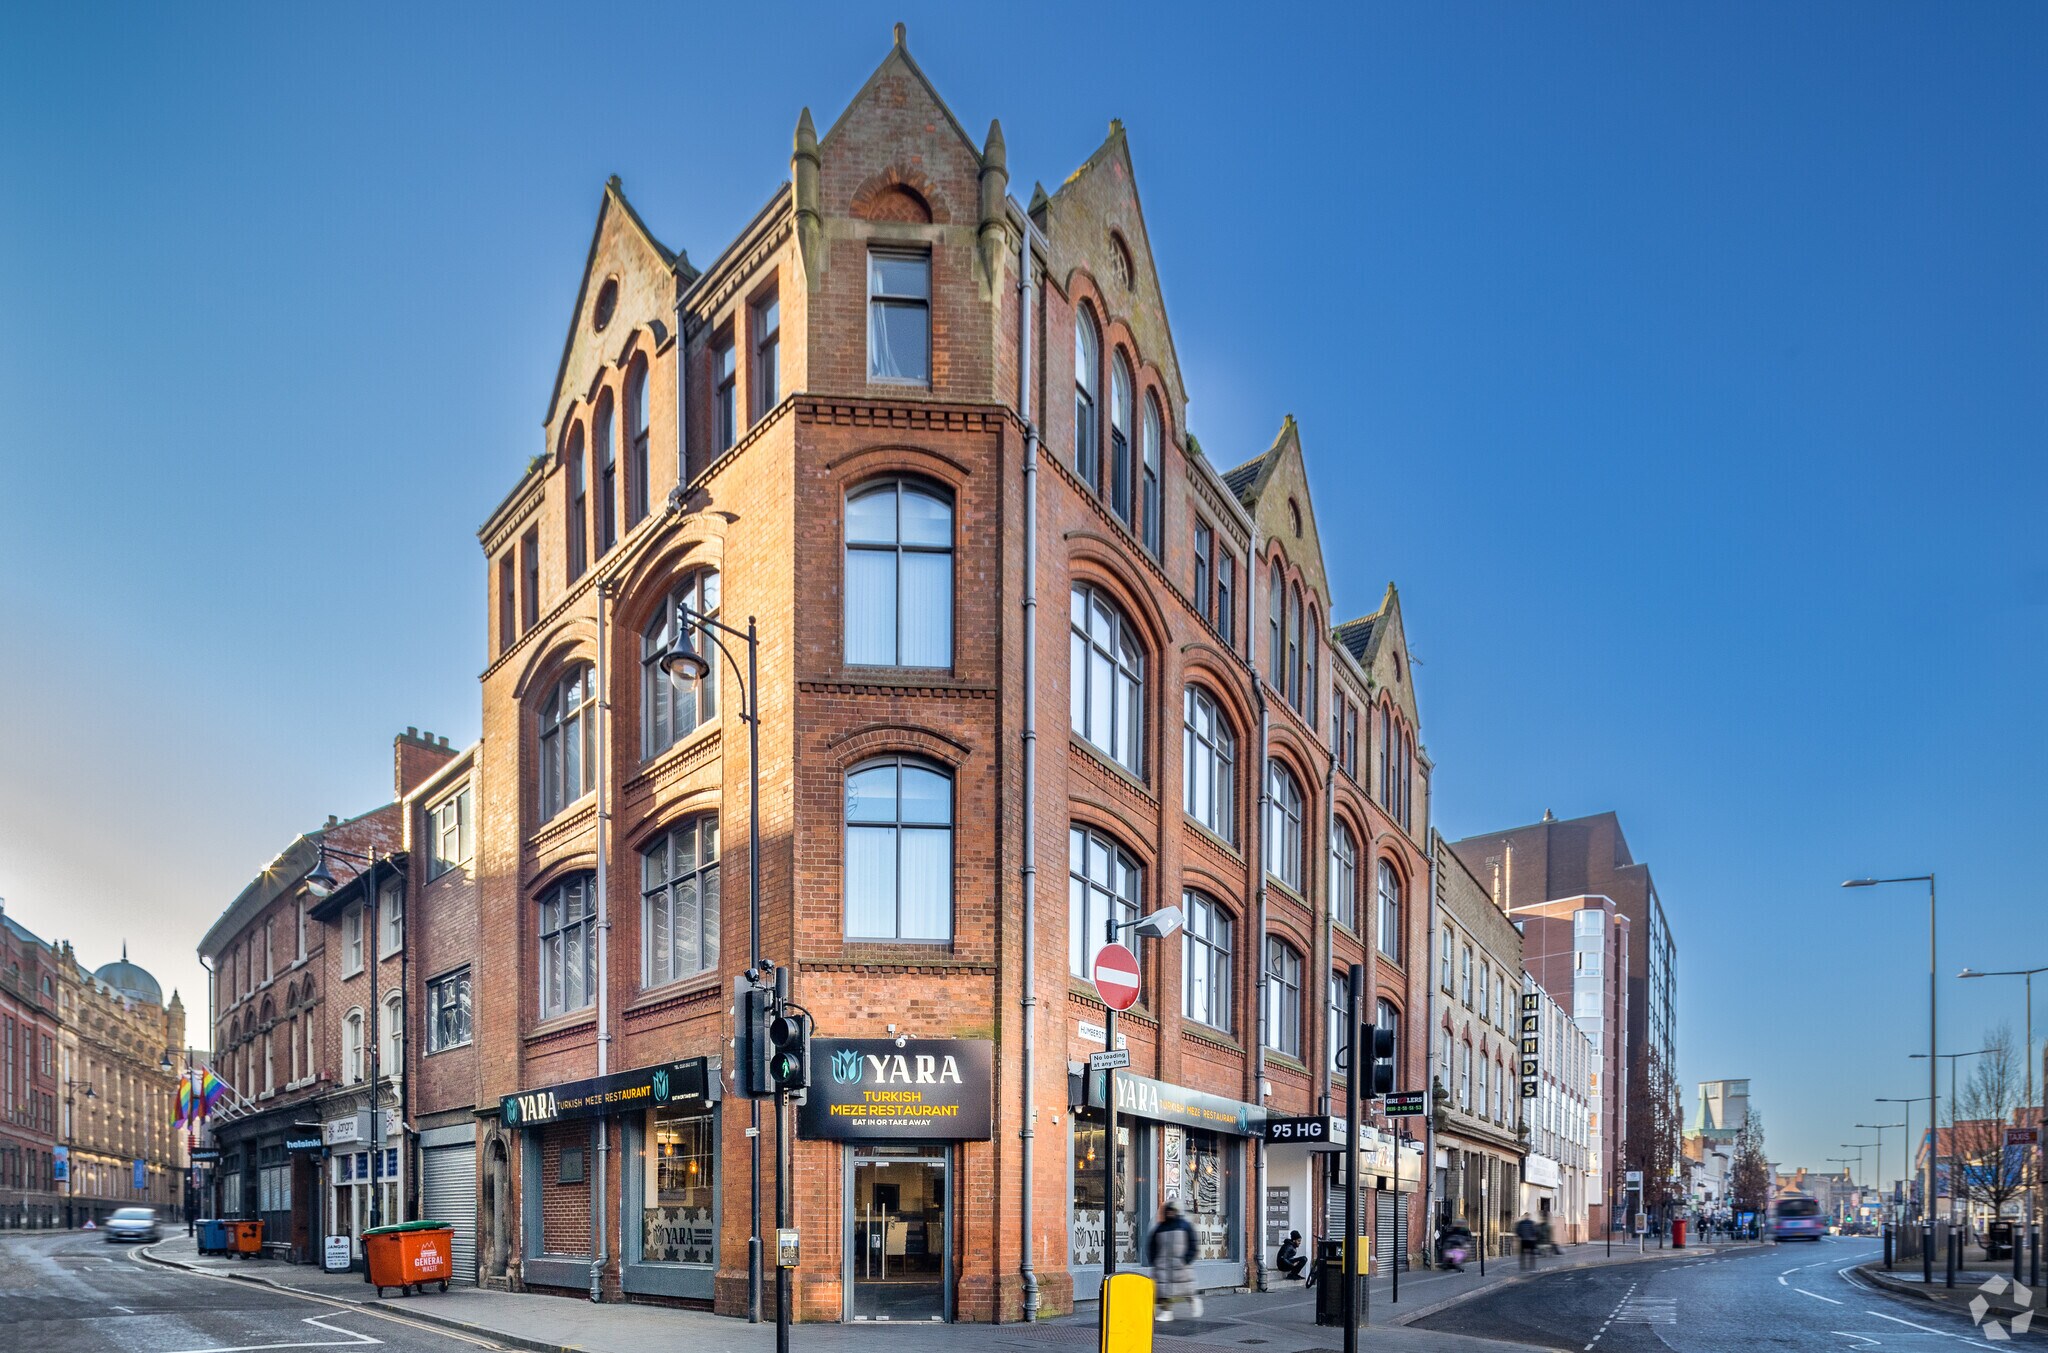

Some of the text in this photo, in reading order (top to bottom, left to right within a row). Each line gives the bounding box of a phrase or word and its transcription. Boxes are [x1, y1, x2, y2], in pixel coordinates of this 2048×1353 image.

[1524, 995, 1537, 1097] HANDS
[867, 1054, 963, 1084] YARA
[517, 1085, 651, 1122] YARA TURKISH MEZE RESTAURANT
[863, 1091, 922, 1102] TURKISH
[1116, 1077, 1159, 1114] YARA
[1159, 1099, 1185, 1114] TURKISH
[1186, 1106, 1202, 1118] MEZE
[1203, 1109, 1238, 1124] RESTAURANT
[830, 1104, 959, 1117] MEZE RESTAURANT
[852, 1118, 931, 1126] EAT IN OR TAKE AWAY
[1272, 1123, 1292, 1138] 95
[1296, 1122, 1322, 1137] HG
[286, 1139, 322, 1149] helsinki
[664, 1227, 694, 1245] YARA
[414, 1256, 443, 1267] GENERAL
